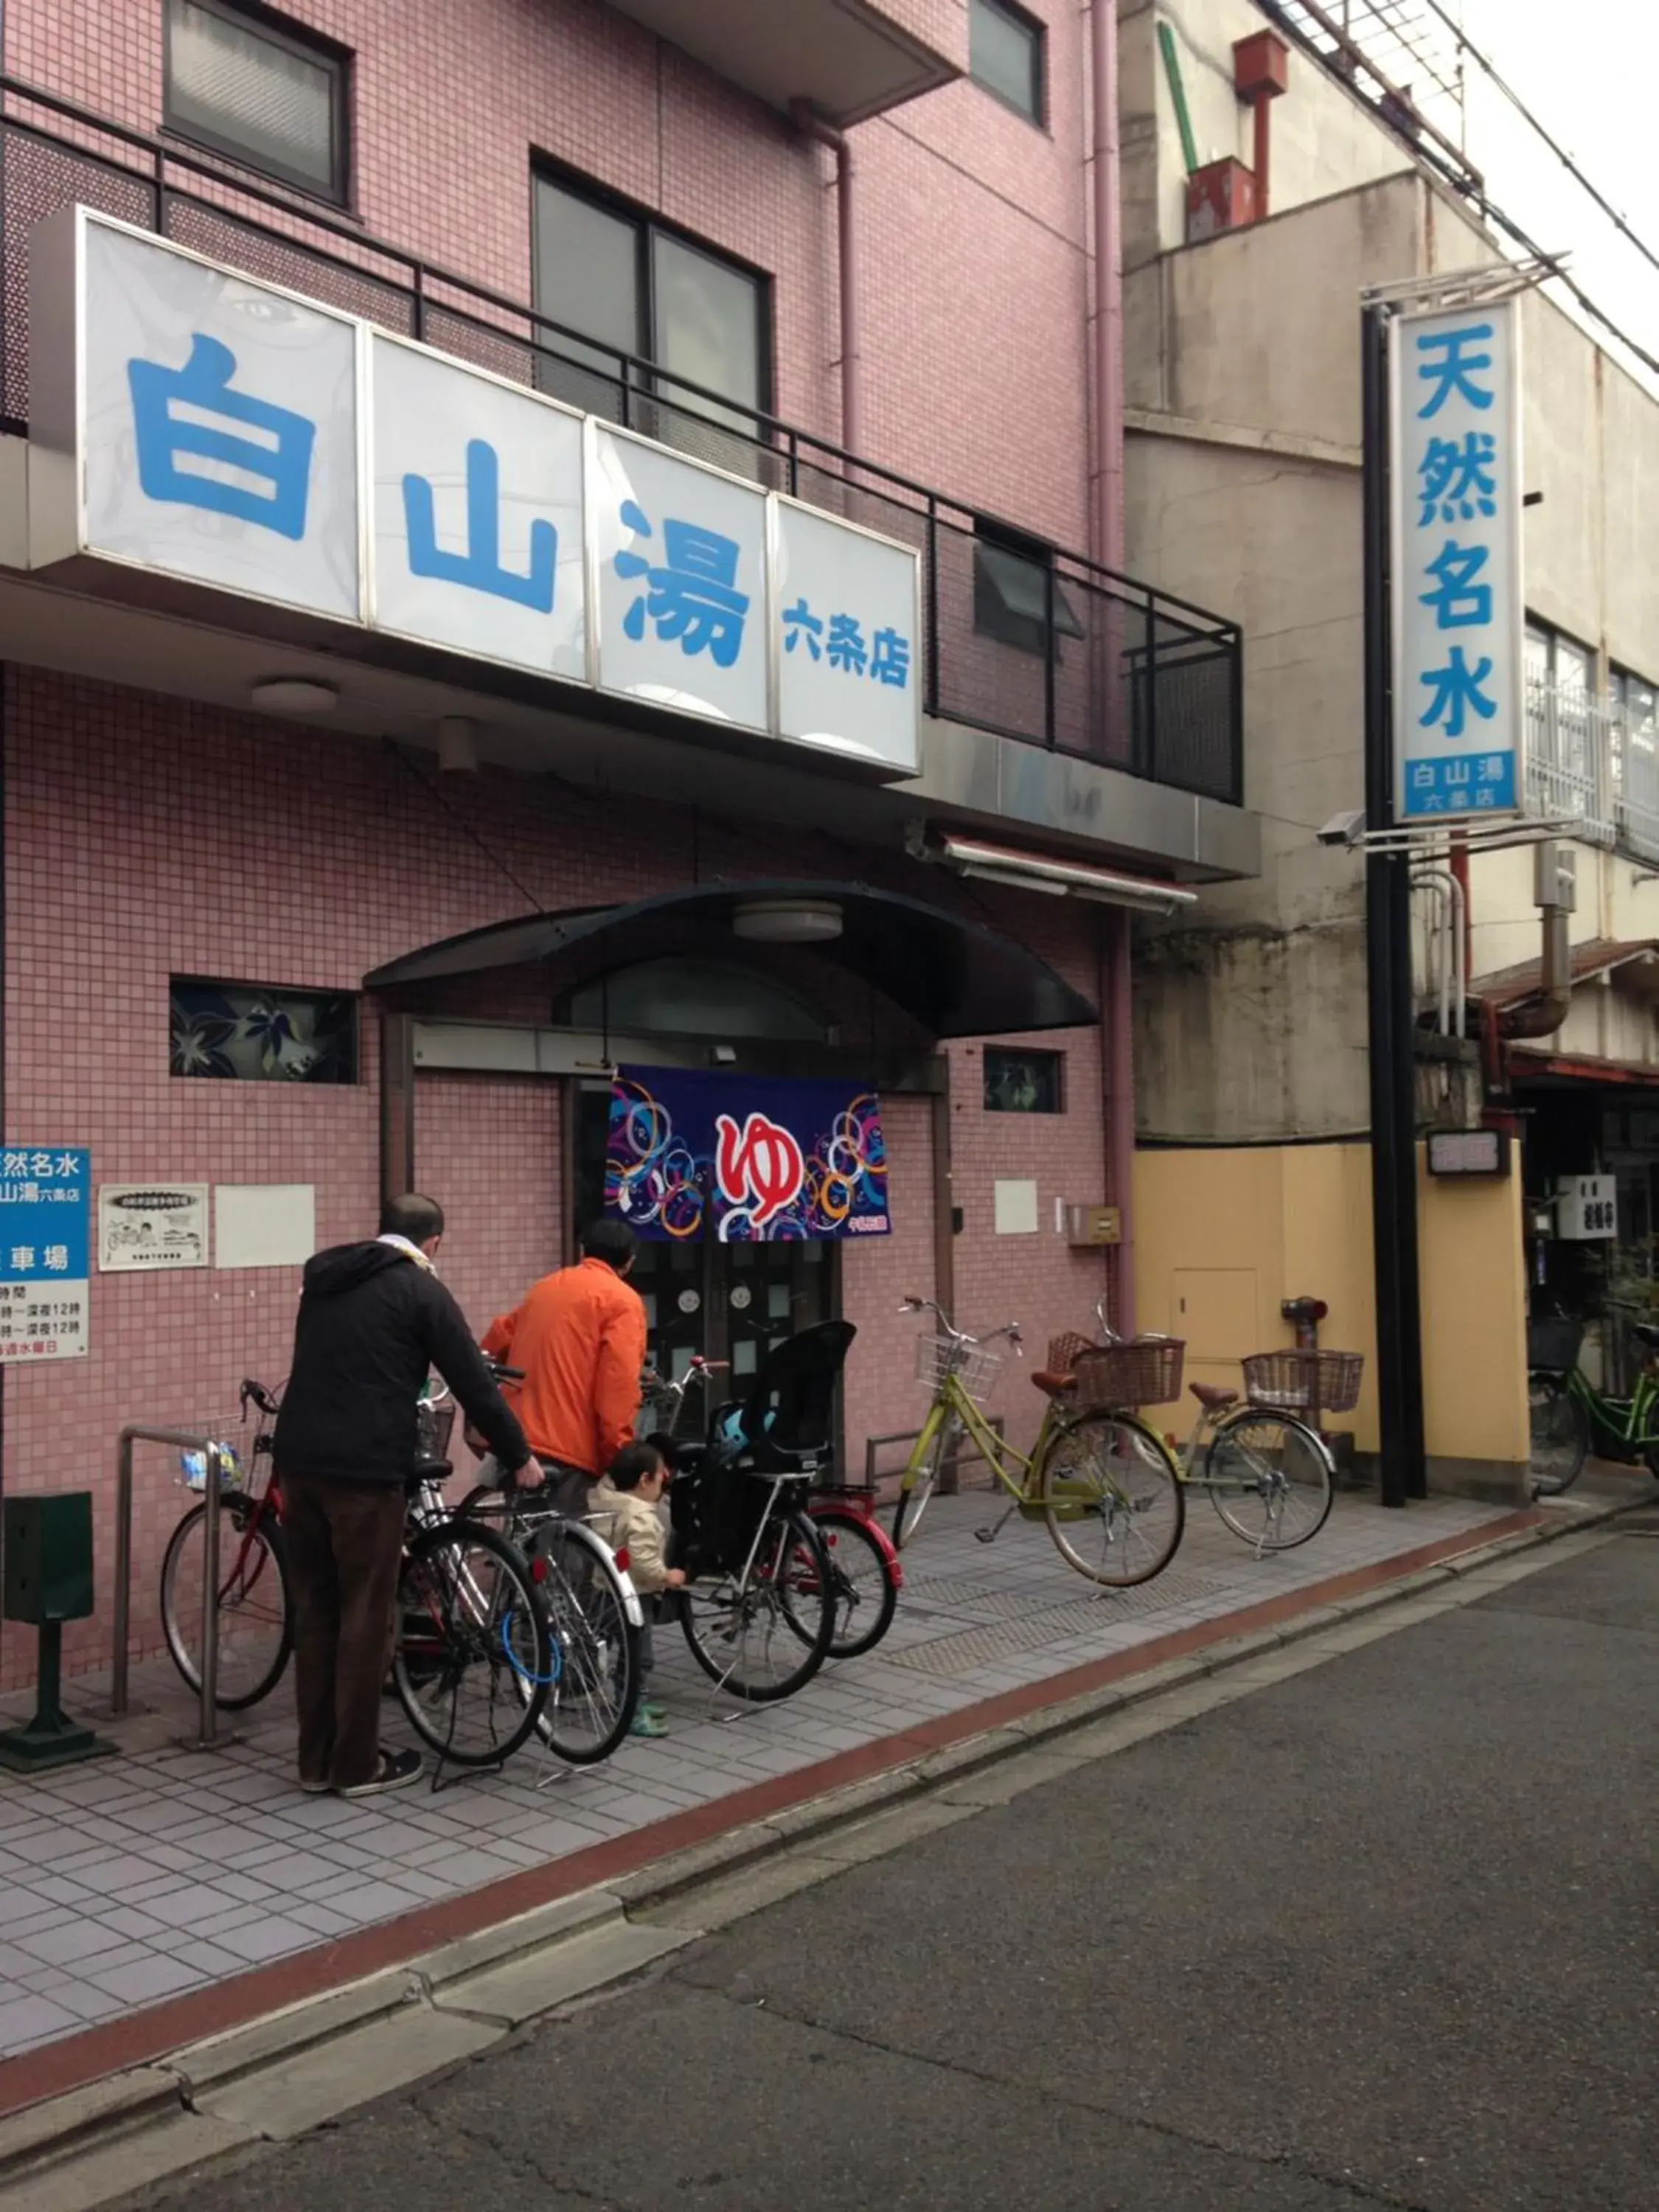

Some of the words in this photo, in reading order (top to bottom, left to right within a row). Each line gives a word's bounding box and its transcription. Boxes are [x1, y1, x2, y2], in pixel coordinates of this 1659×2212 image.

[127, 333, 750, 668] 白山湯
[782, 597, 910, 689] 六条店
[1416, 323, 1498, 737] 天然名水
[1413, 755, 1504, 787] 白山湯
[0, 1152, 80, 1178] 然名水
[715, 1112, 804, 1227] ゆ
[0, 1340, 58, 1356] 週水曜日
